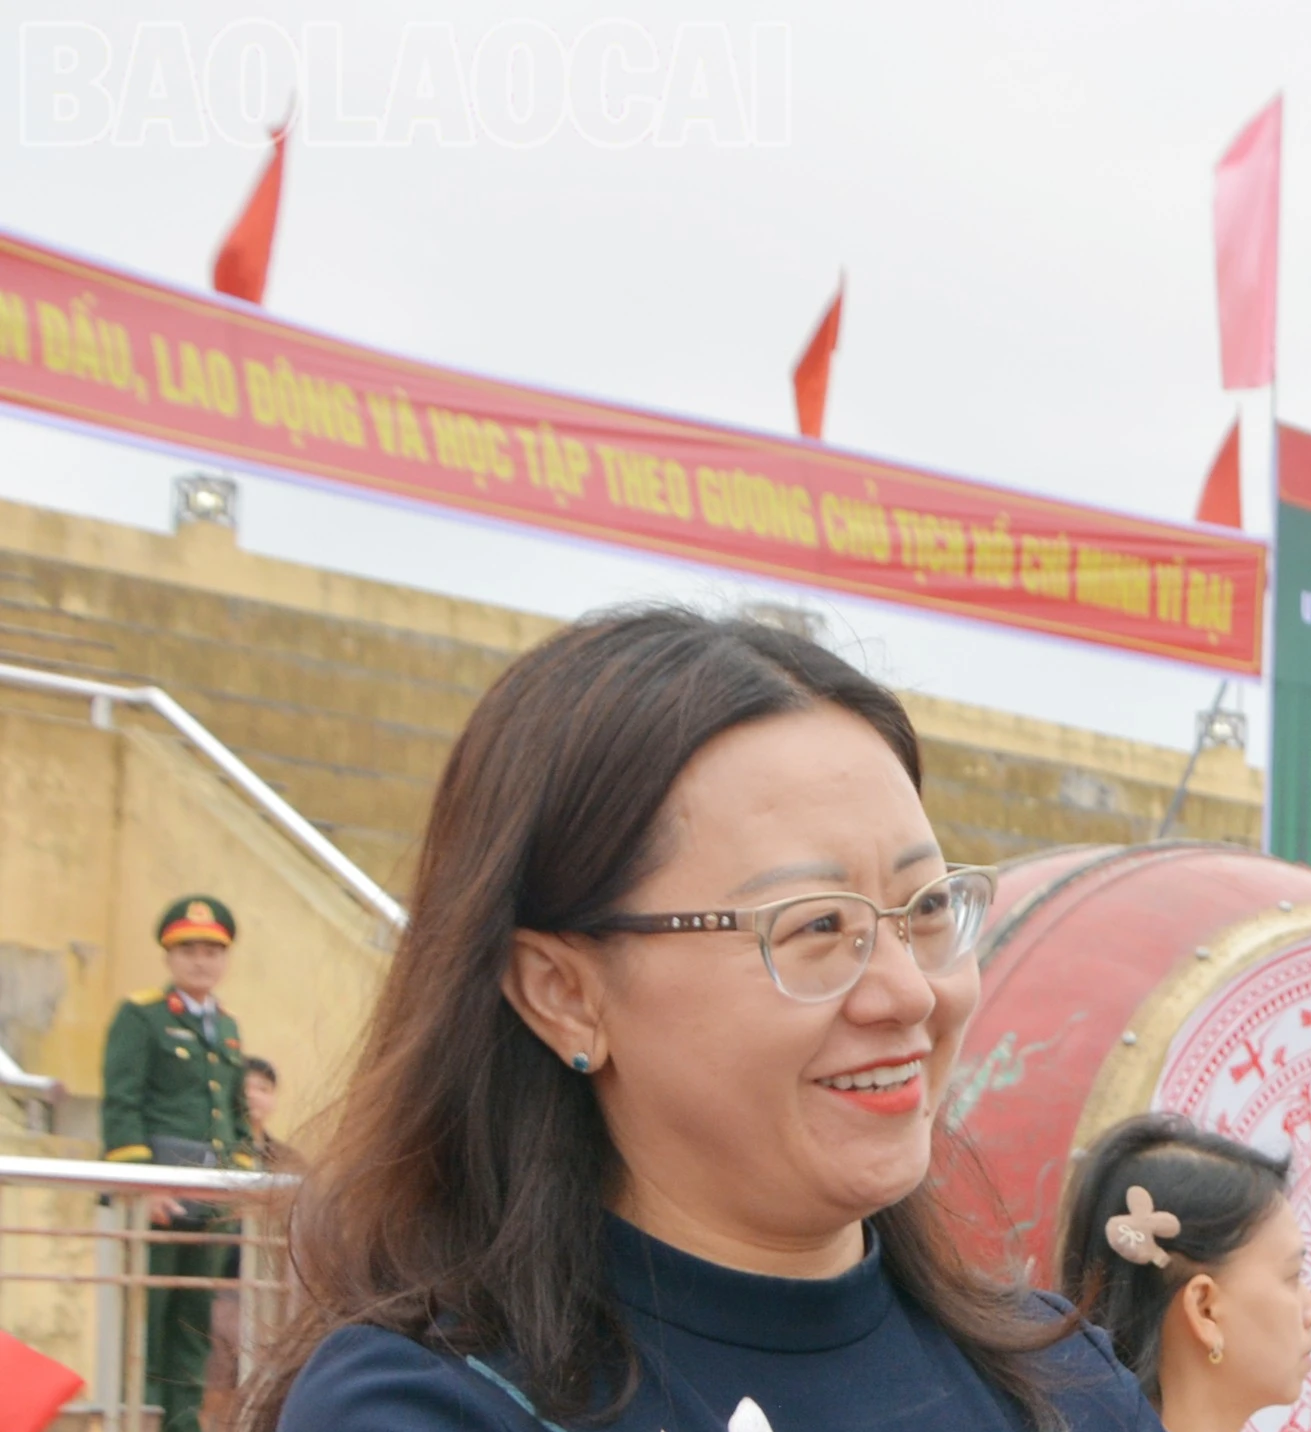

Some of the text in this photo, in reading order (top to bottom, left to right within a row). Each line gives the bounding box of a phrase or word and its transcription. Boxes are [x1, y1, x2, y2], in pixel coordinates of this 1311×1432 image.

[150, 333, 240, 419] LAO
[243, 354, 366, 449] ĐỘNG
[364, 385, 430, 464] VÀ
[427, 406, 516, 490] HỌC
[514, 419, 592, 507] TẬP
[595, 443, 694, 522] THEO
